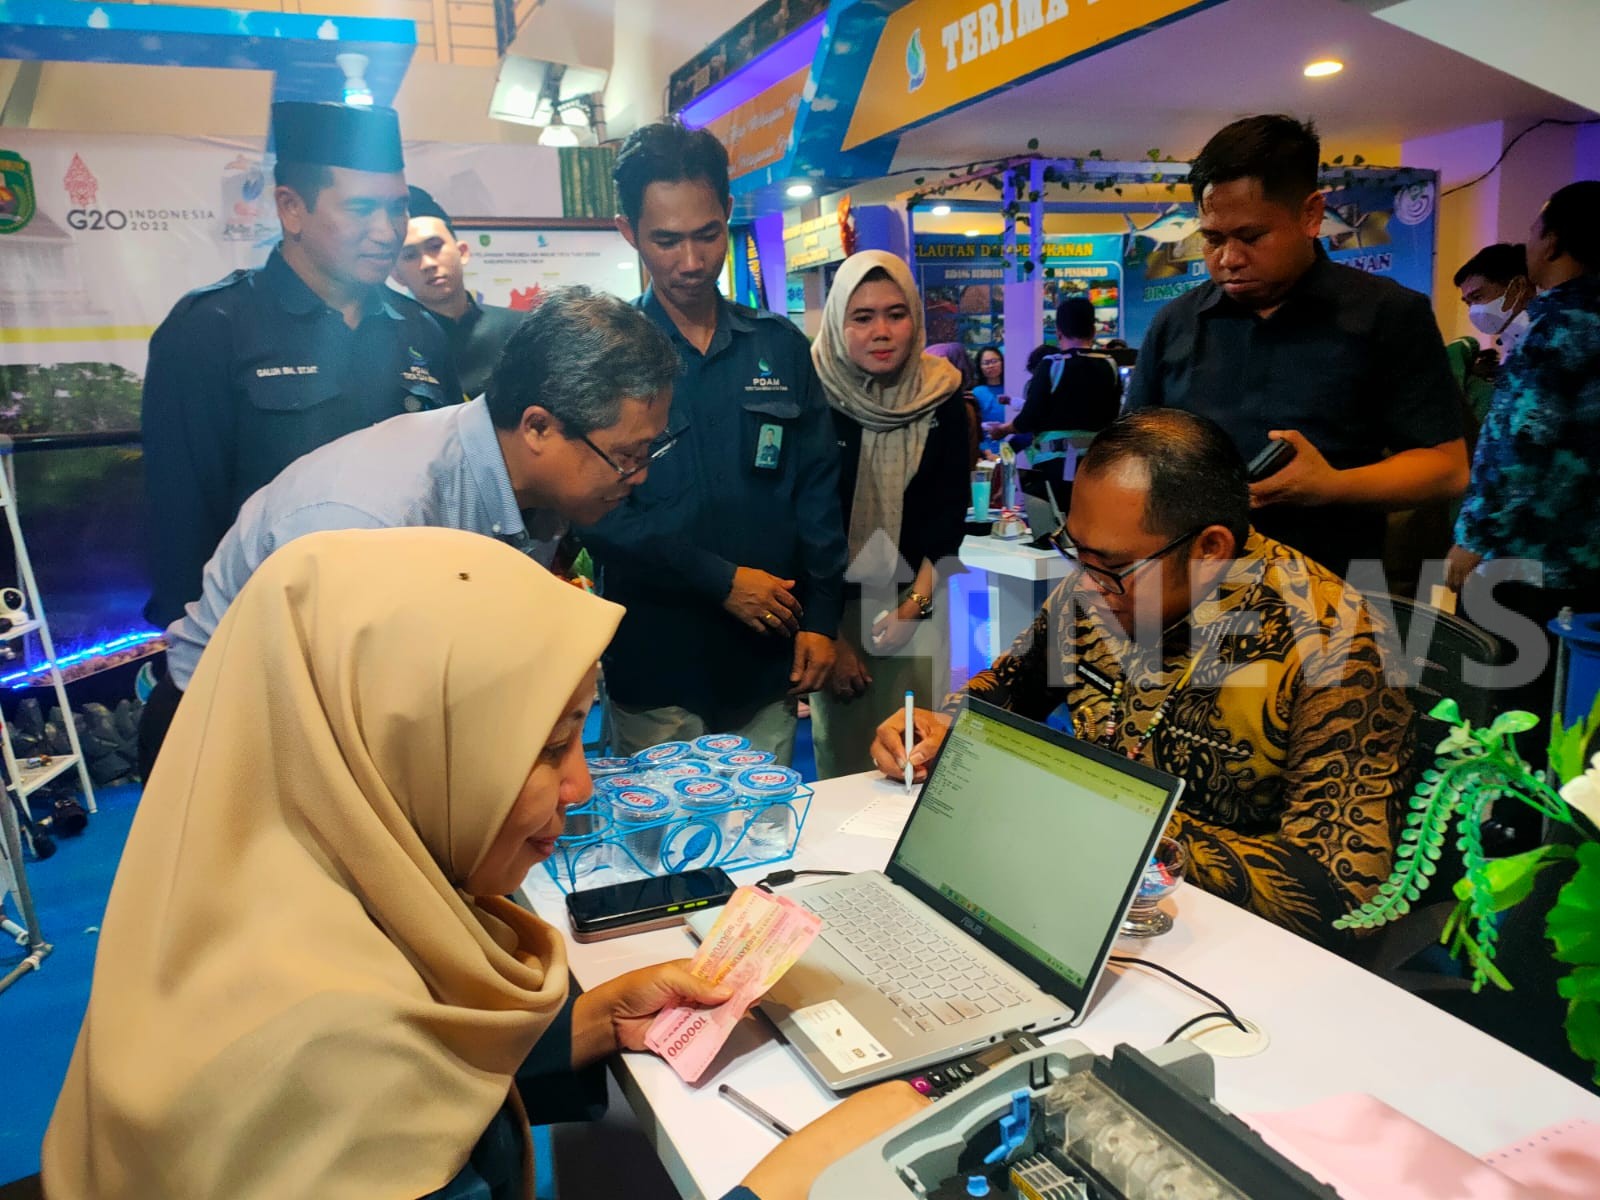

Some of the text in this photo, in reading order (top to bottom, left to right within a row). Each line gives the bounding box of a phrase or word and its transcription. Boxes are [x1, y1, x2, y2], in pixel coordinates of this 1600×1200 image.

[66, 208, 216, 231] G20 INDONESIA
[131, 221, 169, 231] 2022
[752, 378, 780, 386] PDAM
[960, 916, 984, 936] ASUS
[665, 1015, 708, 1057] 100000
